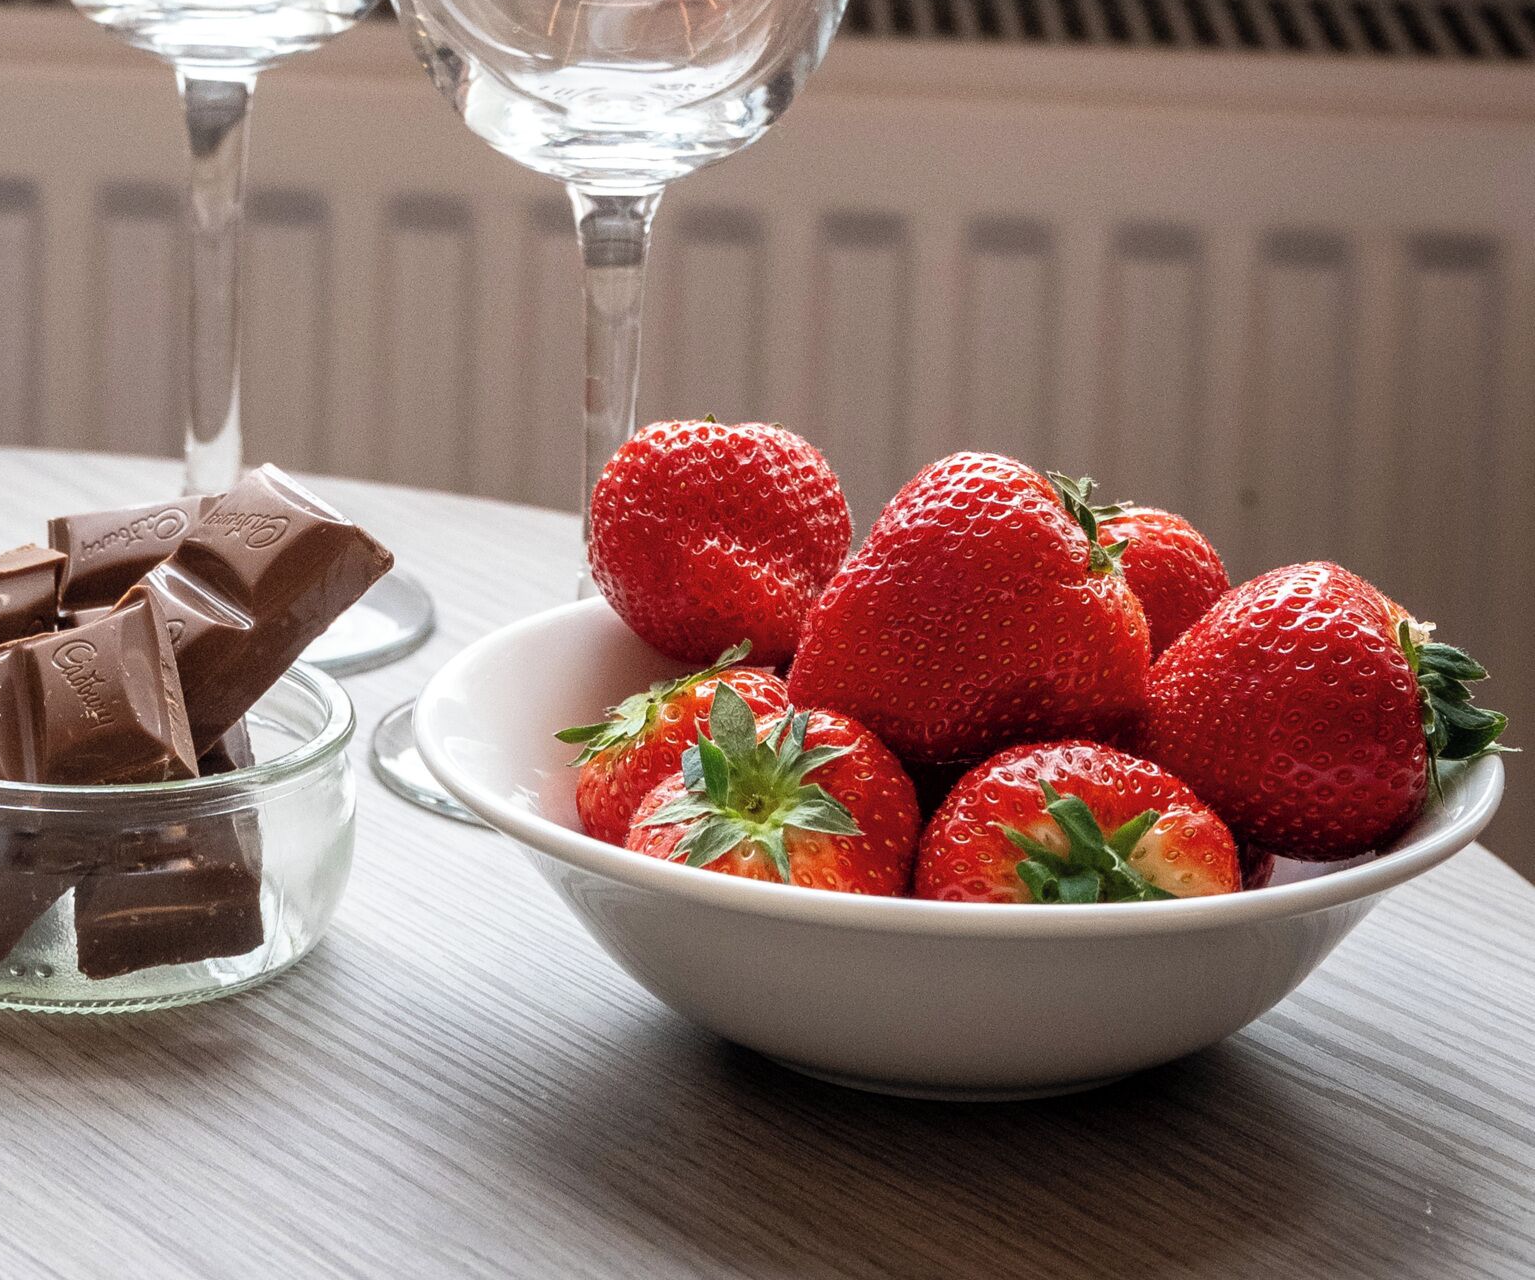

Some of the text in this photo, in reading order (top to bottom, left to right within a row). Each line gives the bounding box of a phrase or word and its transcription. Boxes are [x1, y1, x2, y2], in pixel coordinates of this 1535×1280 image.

[81, 507, 189, 561] Cadbury
[203, 504, 291, 551] Cadbury
[52, 639, 115, 731] Cadbury
